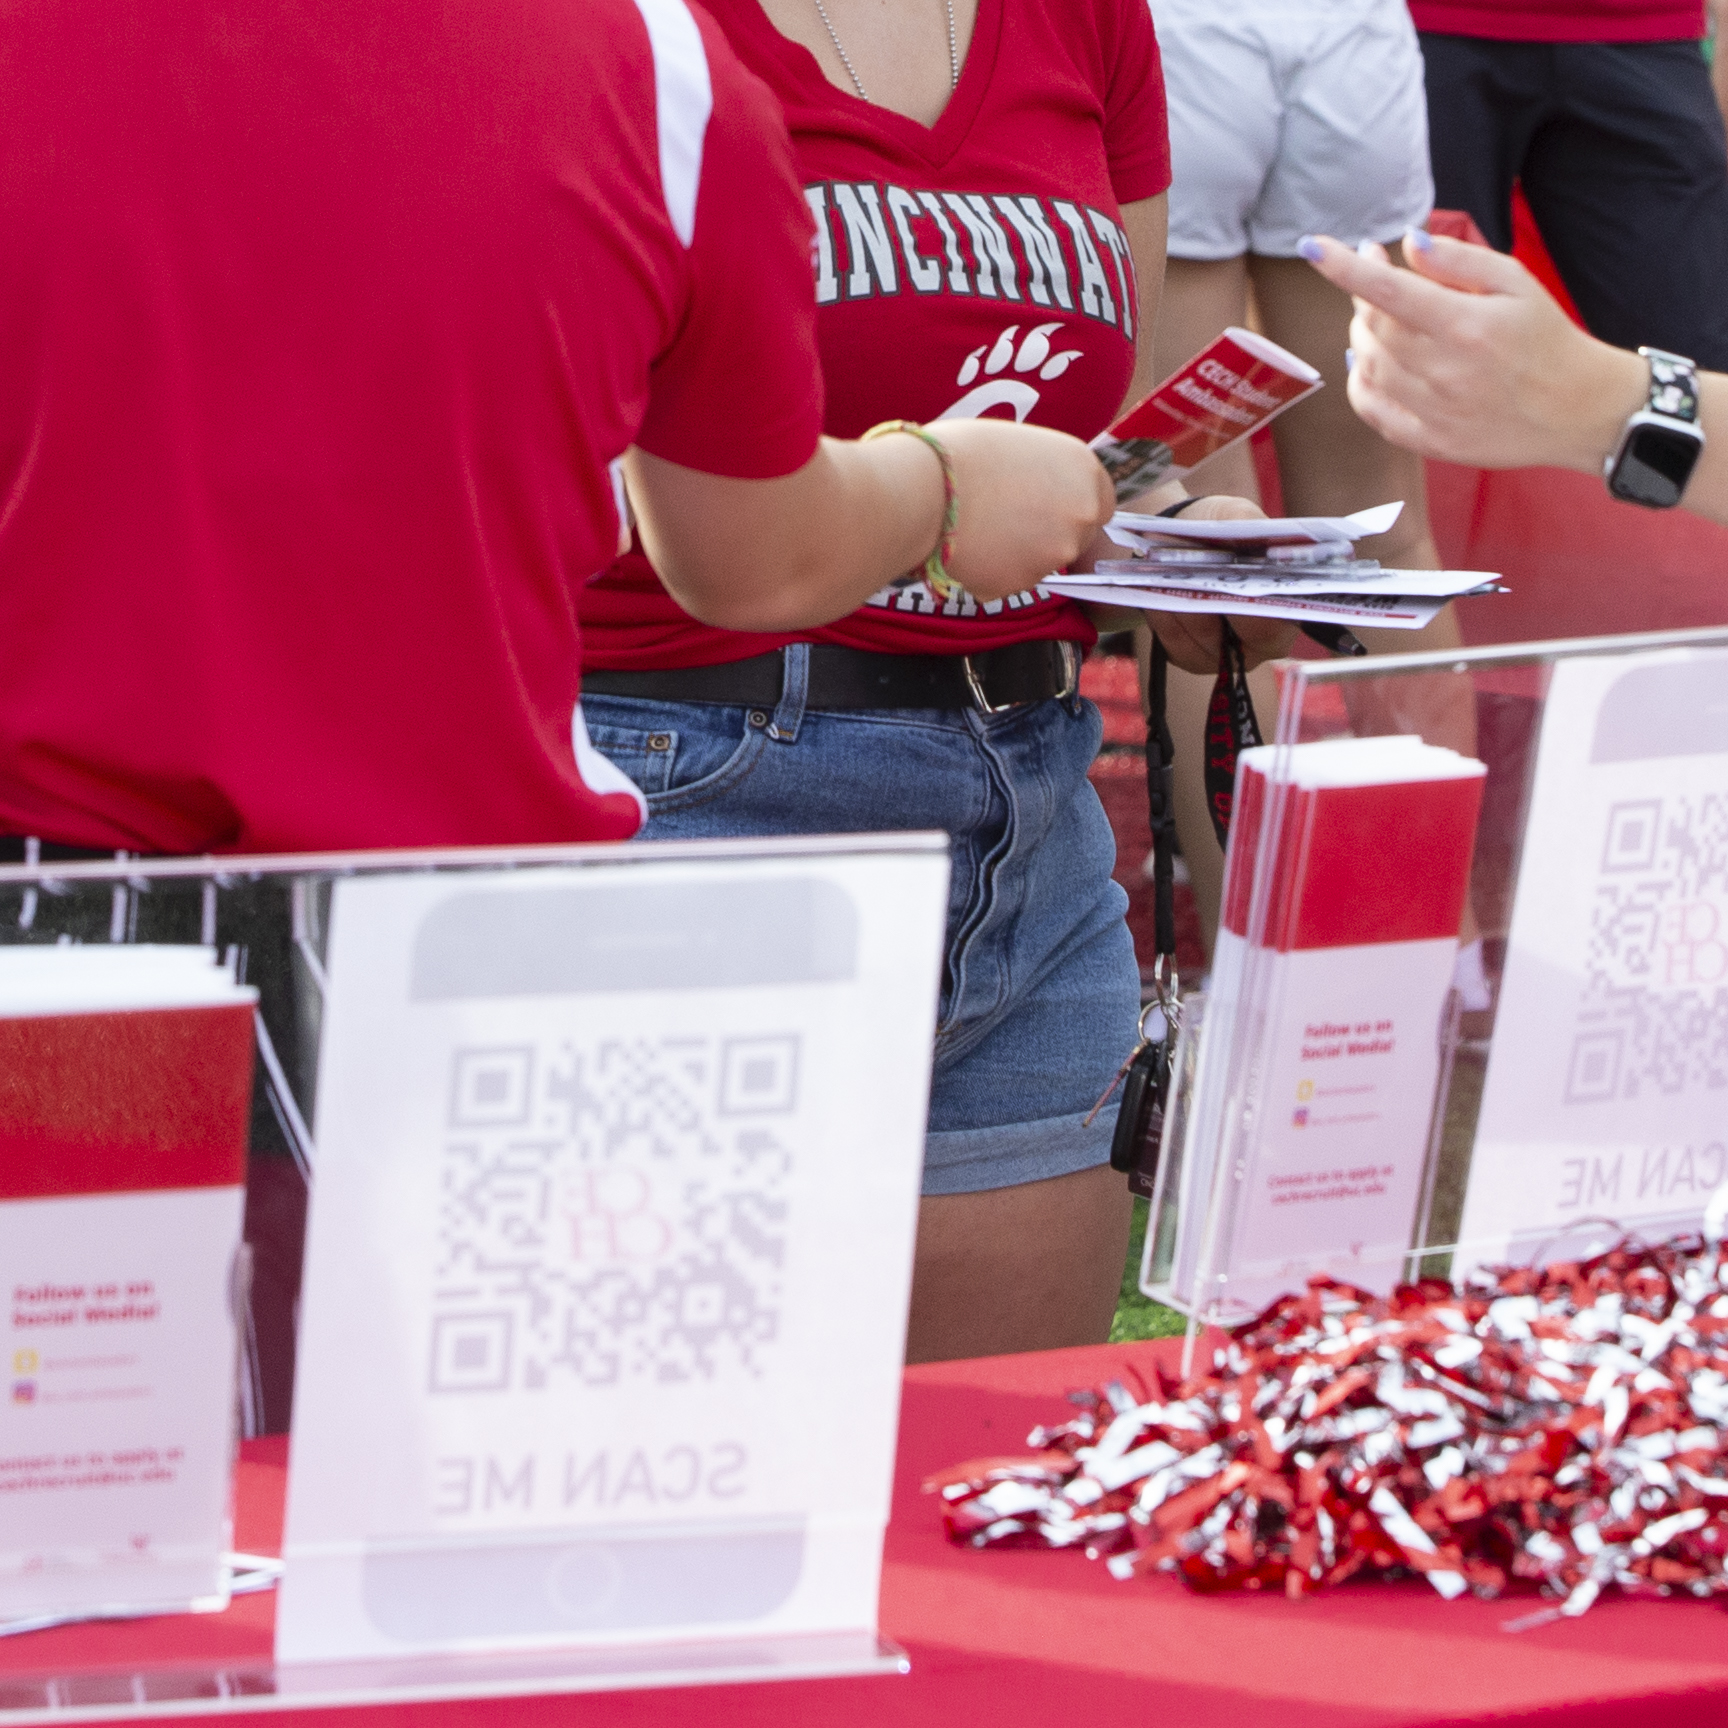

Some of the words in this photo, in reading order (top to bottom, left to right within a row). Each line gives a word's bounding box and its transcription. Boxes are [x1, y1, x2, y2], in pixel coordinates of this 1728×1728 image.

[803, 180, 1141, 343] INCINNAT
[1355, 1022, 1371, 1035] us
[1375, 1019, 1393, 1033] on
[1301, 1043, 1342, 1062] Social
[94, 1284, 119, 1300] us
[126, 1281, 155, 1298] on
